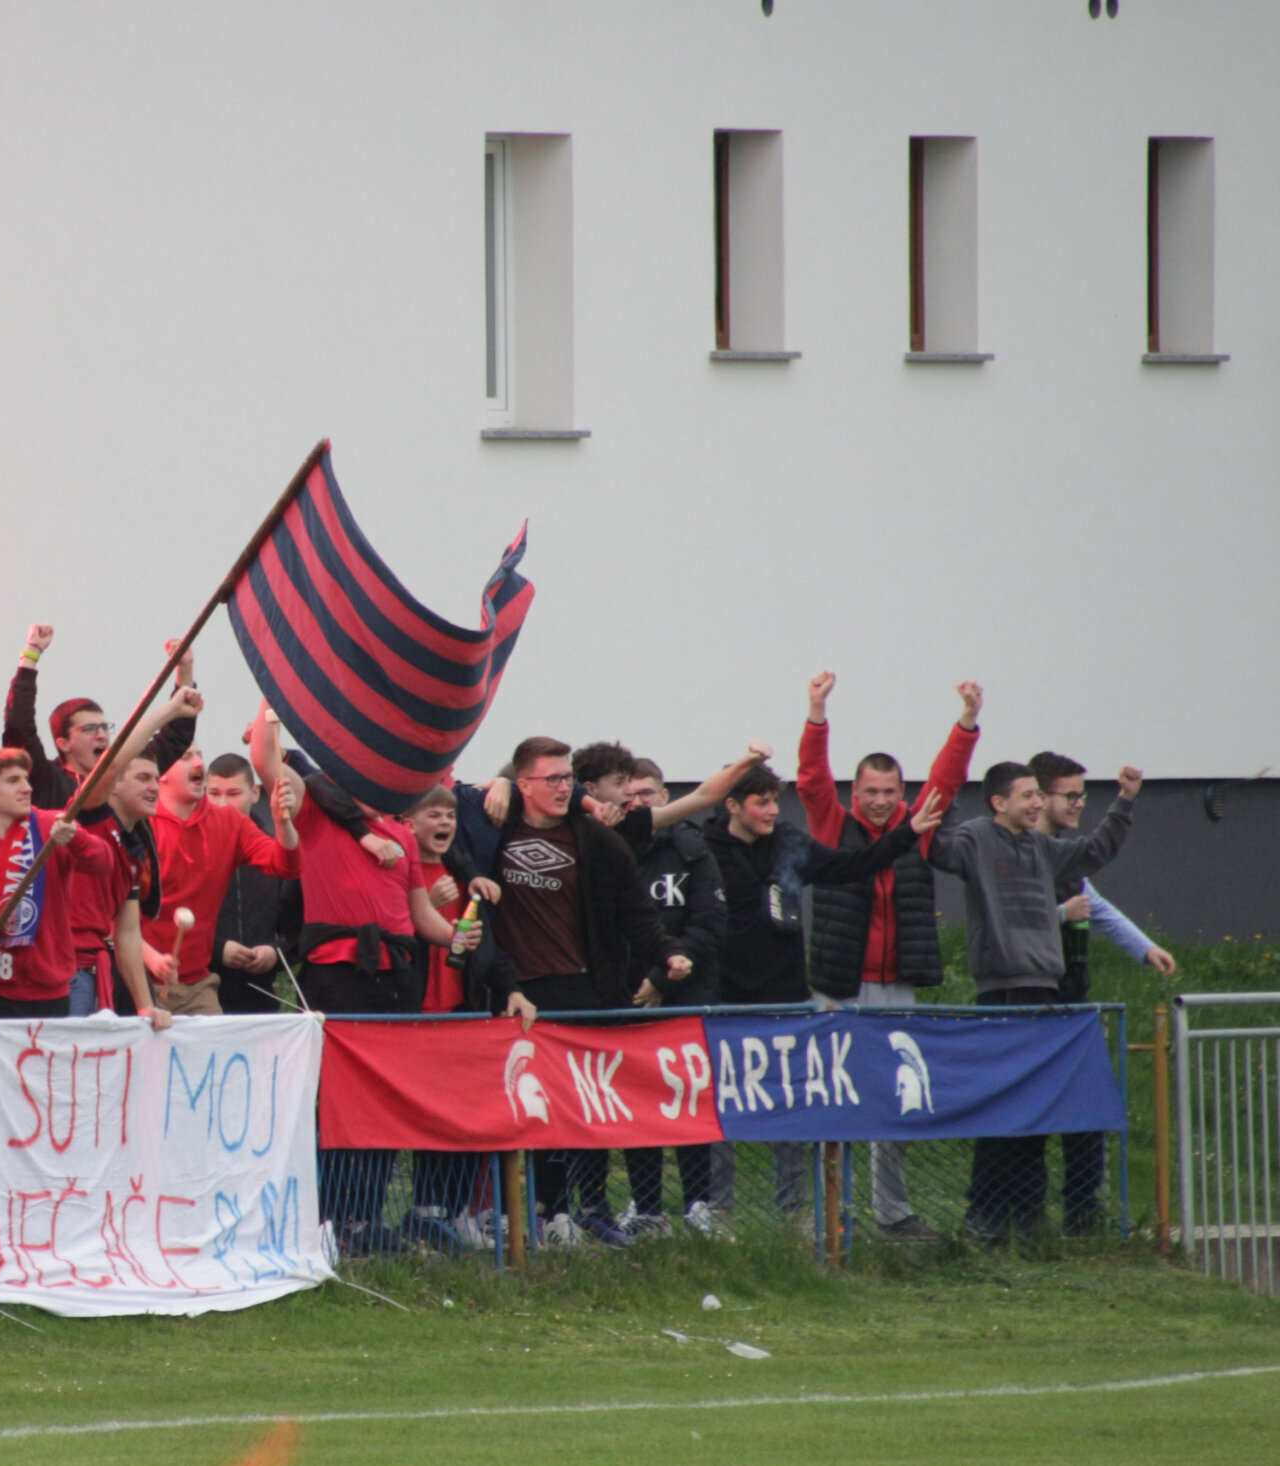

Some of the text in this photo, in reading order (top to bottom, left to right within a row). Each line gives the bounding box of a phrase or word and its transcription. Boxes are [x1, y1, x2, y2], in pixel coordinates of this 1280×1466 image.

[503, 868, 562, 891] umbro
[7, 1021, 279, 1158] ŠUTI MOJ
[567, 1031, 860, 1125] NK SPARTAK
